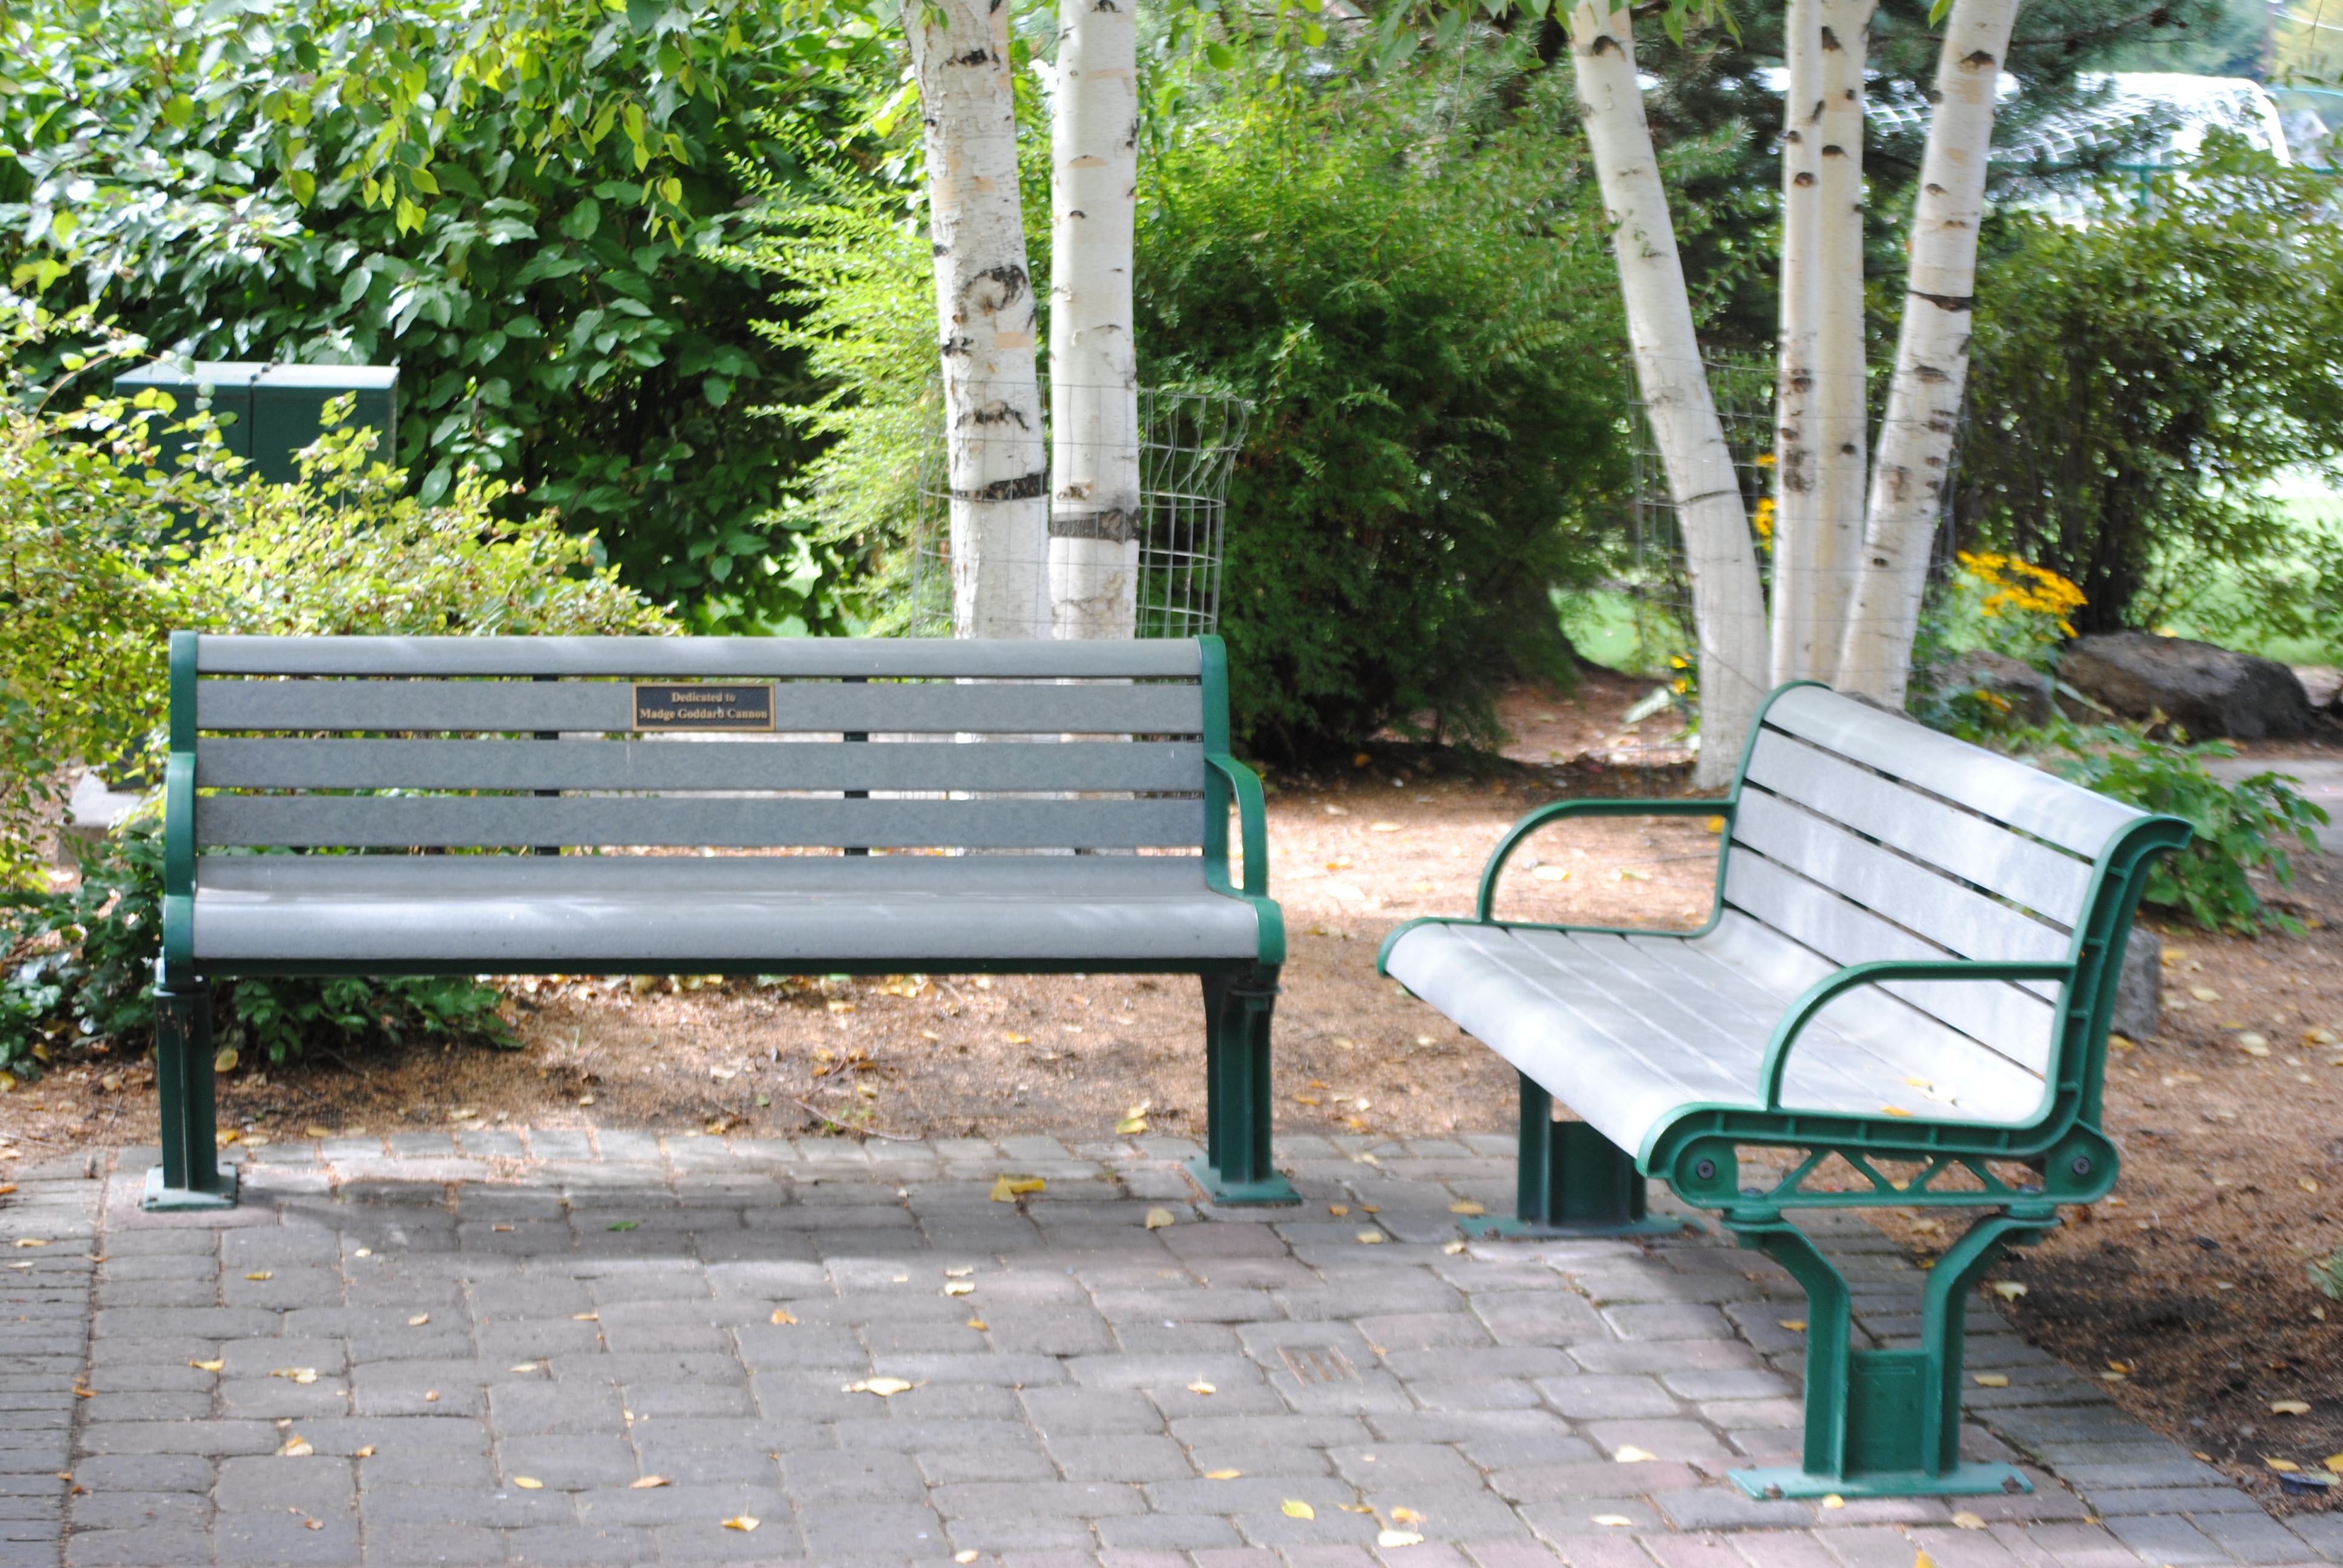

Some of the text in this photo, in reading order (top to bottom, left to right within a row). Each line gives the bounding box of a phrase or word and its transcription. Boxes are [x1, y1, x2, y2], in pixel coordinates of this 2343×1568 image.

[671, 692, 736, 702] Dedicated to
[640, 708, 767, 721] Madge Goddard Cannon
